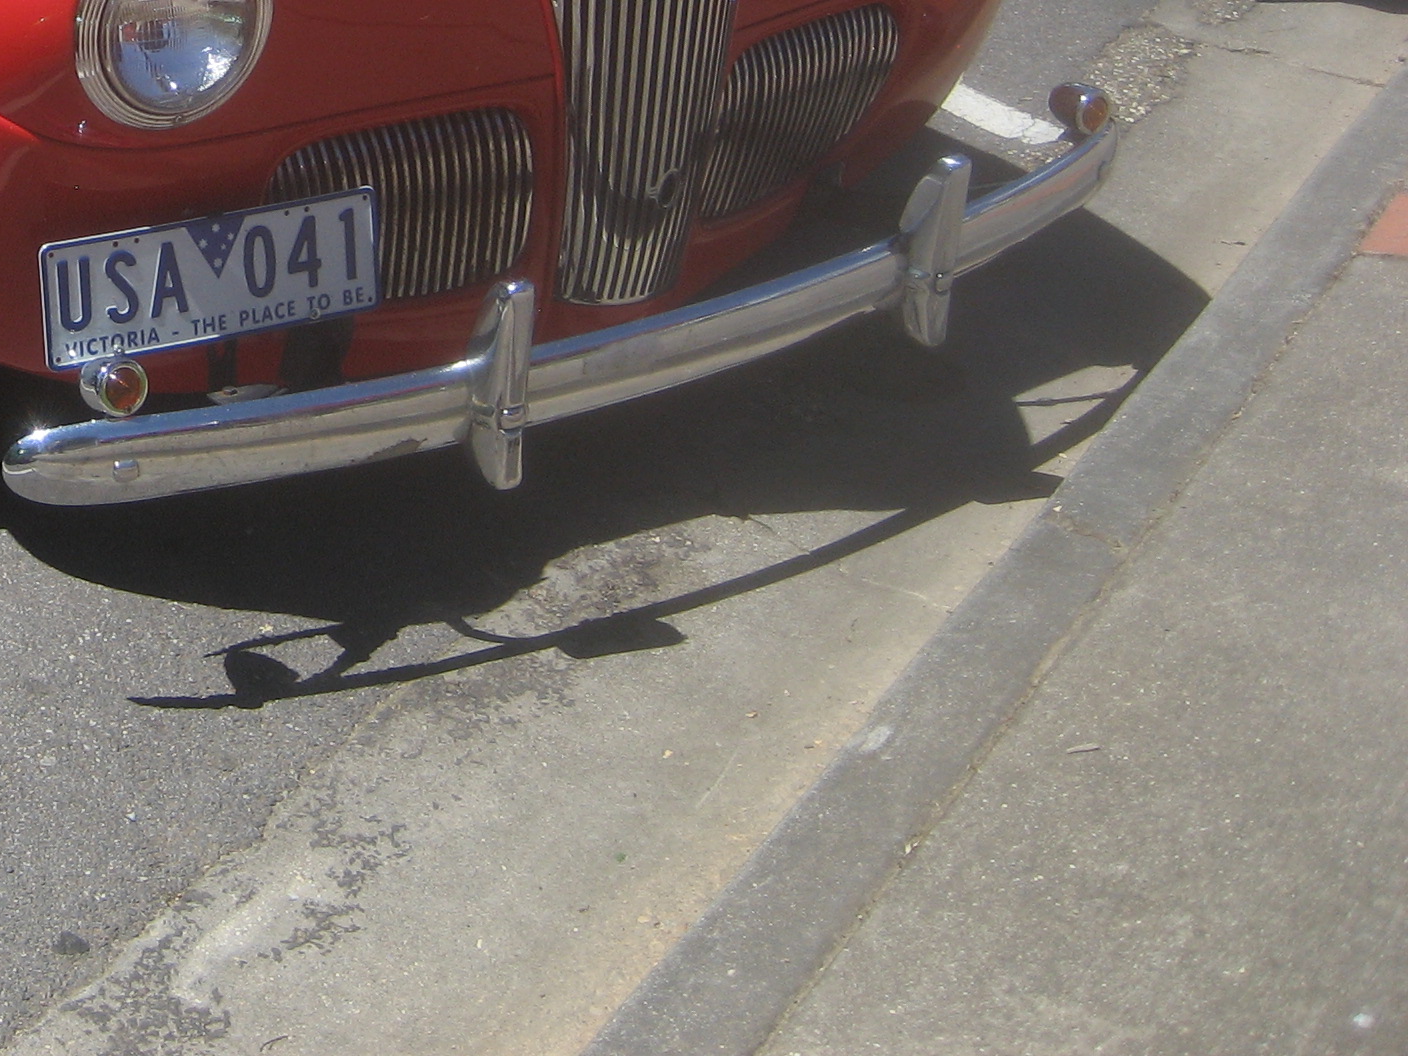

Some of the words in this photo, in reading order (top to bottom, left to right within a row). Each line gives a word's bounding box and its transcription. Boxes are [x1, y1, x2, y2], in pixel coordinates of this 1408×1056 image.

[56, 241, 189, 332] USA
[243, 207, 358, 298] 041
[65, 327, 160, 359] VICTORIA
[191, 314, 228, 336] THE
[239, 300, 297, 327] PLACE
[306, 294, 331, 315] TO
